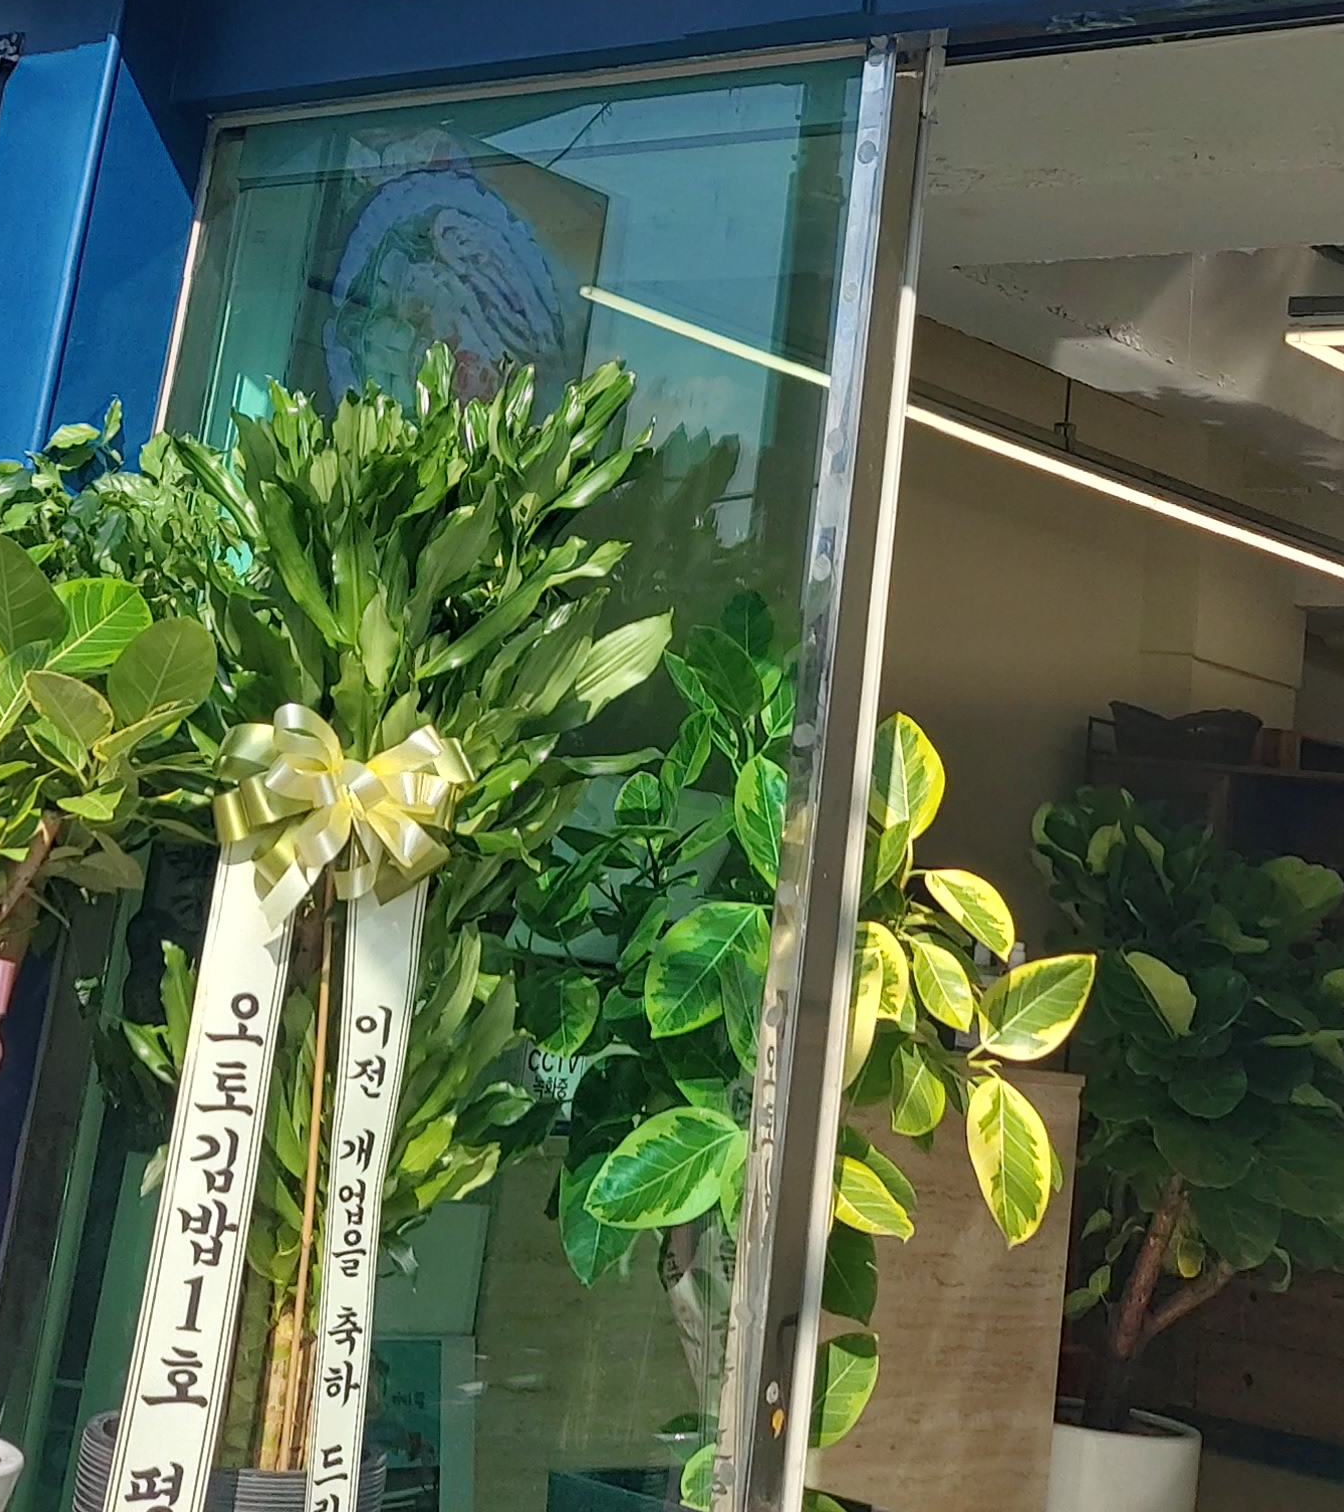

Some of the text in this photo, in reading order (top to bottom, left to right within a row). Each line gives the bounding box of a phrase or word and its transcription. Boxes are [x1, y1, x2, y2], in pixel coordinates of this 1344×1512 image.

[349, 1005, 393, 1099] 이전
[331, 1128, 376, 1278] 개업을
[323, 1305, 363, 1408] 축하
